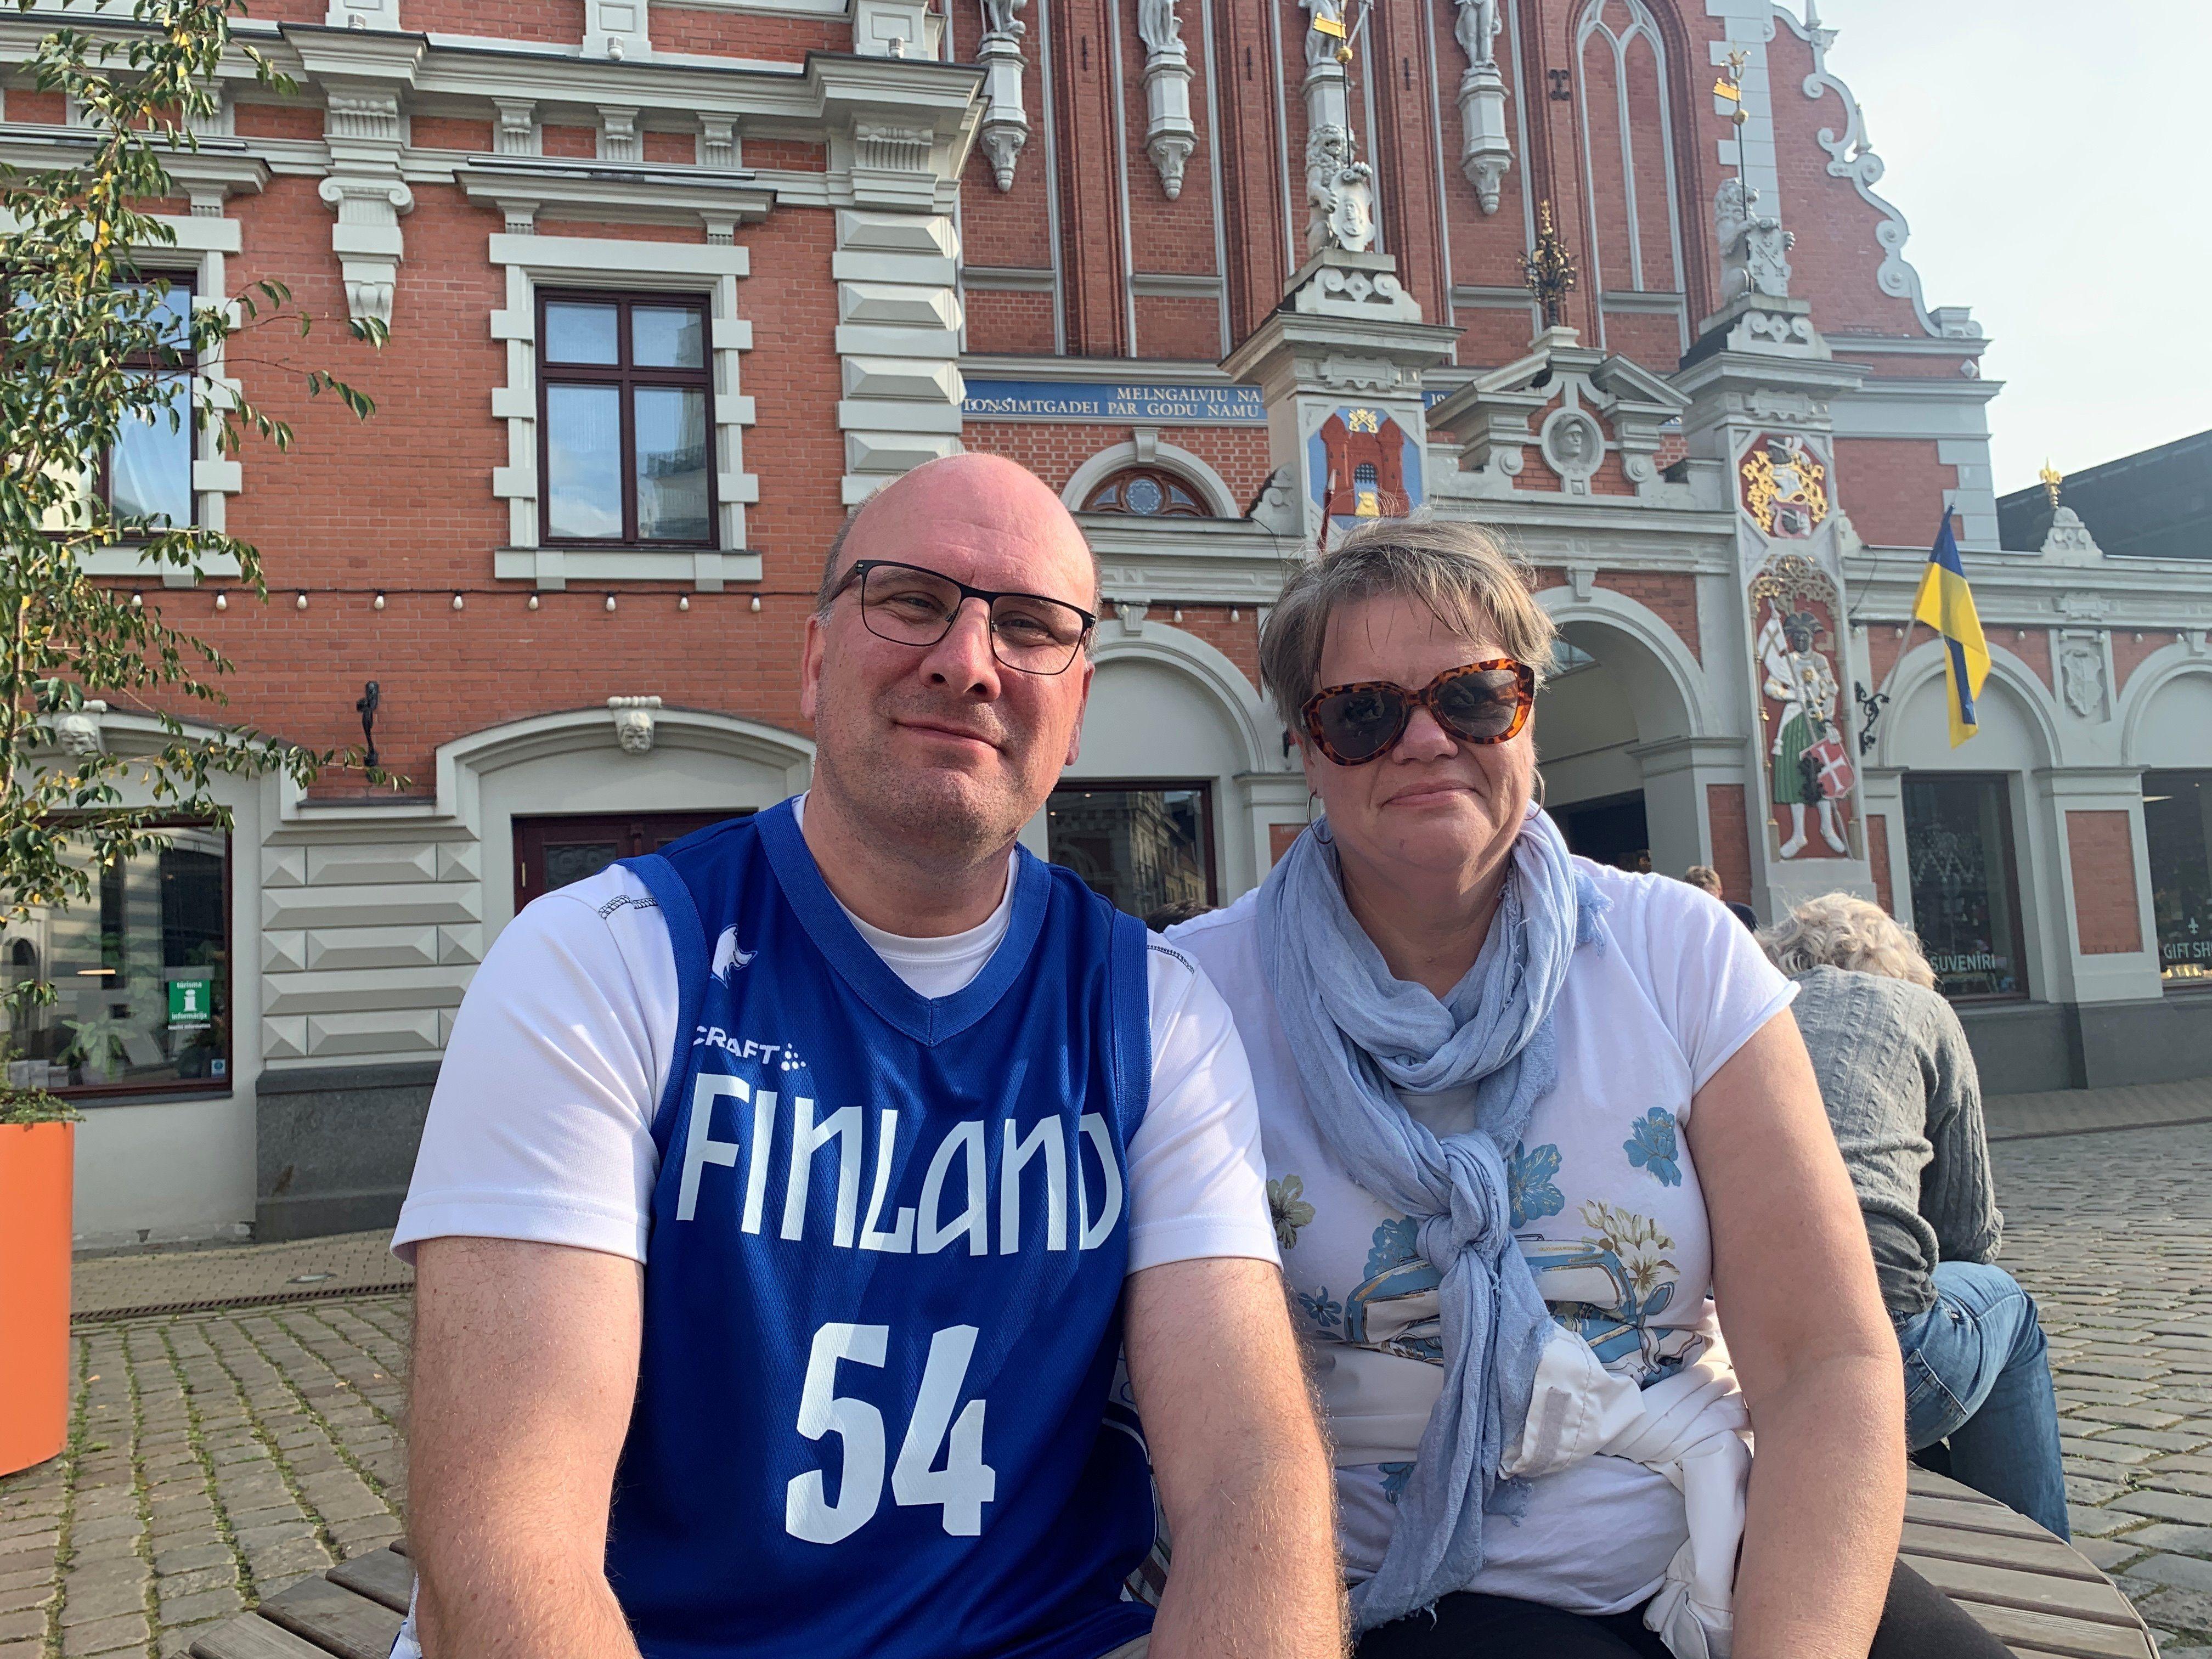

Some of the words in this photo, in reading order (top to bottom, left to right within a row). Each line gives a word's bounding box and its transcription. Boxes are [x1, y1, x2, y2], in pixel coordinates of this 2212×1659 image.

[1117, 387, 1228, 403] MELNGALVJU
[1108, 402, 1139, 415] PAR
[1147, 403, 1198, 416] GODU
[1206, 404, 1259, 417] NAMU
[2163, 942, 2190, 960] GIFT
[693, 1025, 781, 1064] CRAFT
[675, 1072, 1124, 1256] FINLAND
[785, 1324, 996, 1545] 54
